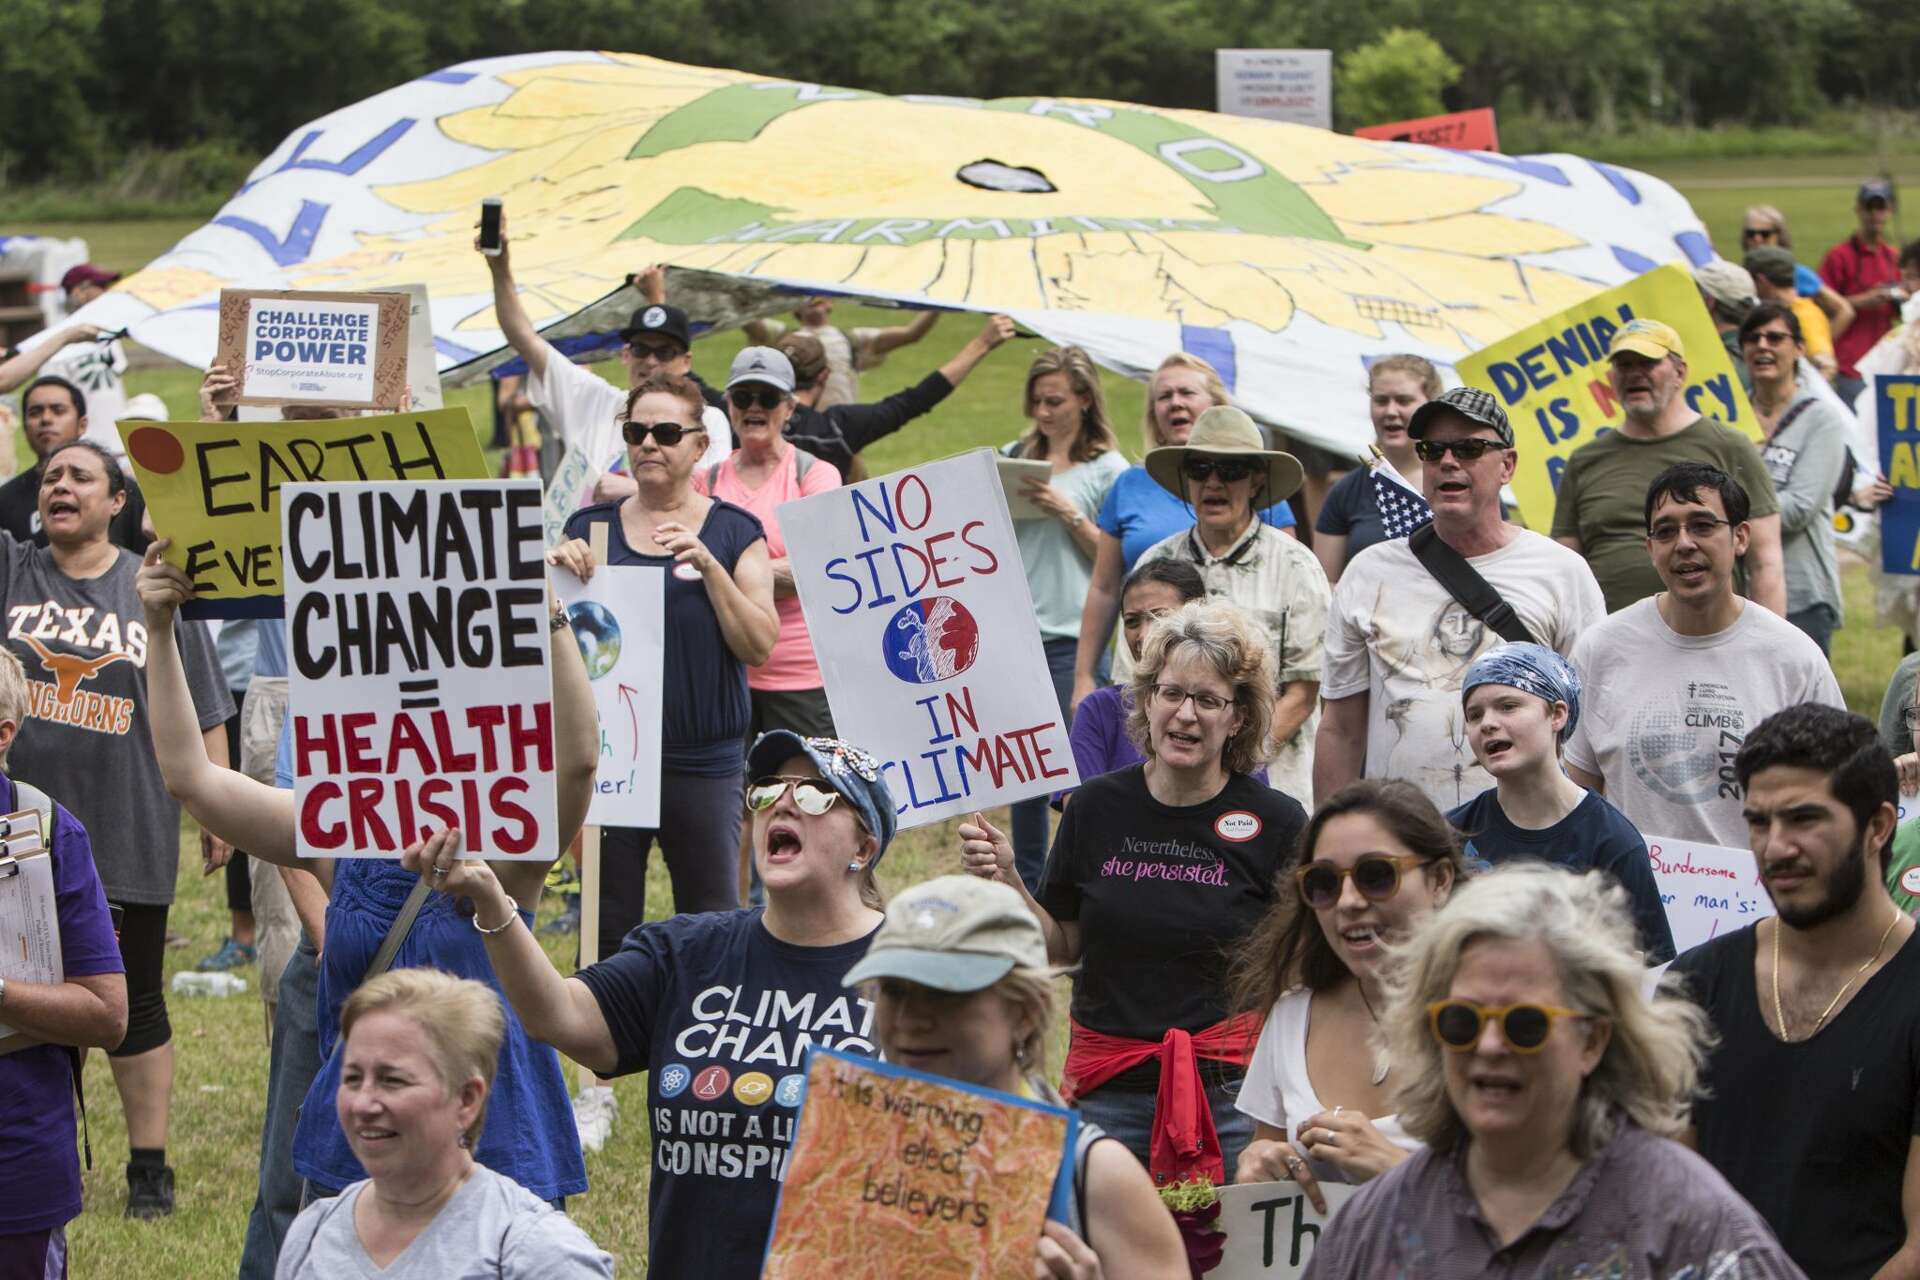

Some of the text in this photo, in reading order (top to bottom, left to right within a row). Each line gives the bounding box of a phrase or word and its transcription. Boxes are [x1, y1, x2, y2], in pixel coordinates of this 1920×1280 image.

[255, 326, 368, 342] CORPORATE
[256, 310, 369, 328] CHALLENGE
[255, 341, 367, 365] POWER
[256, 368, 364, 381] StopCorporateAbuse.org
[1535, 397, 1580, 446] IS
[195, 421, 446, 517] EARTH
[851, 474, 932, 542] NO
[288, 489, 546, 583] CLIMATE
[184, 539, 283, 592] EVE
[8, 600, 149, 669] TEXAS
[292, 586, 544, 680] CHANGE
[294, 702, 554, 777] HEALTH
[916, 687, 980, 745] IN
[1718, 730, 1745, 801] 2017
[300, 776, 540, 855] CRISIS
[1101, 856, 1134, 877] she
[1648, 844, 1737, 880] Burdensome
[691, 984, 876, 1038] CLIMAT
[655, 1107, 673, 1134] IS
[680, 1109, 737, 1137] NOT
[743, 1115, 765, 1139] A
[903, 1129, 969, 1174] elect
[862, 1164, 990, 1228] believers
